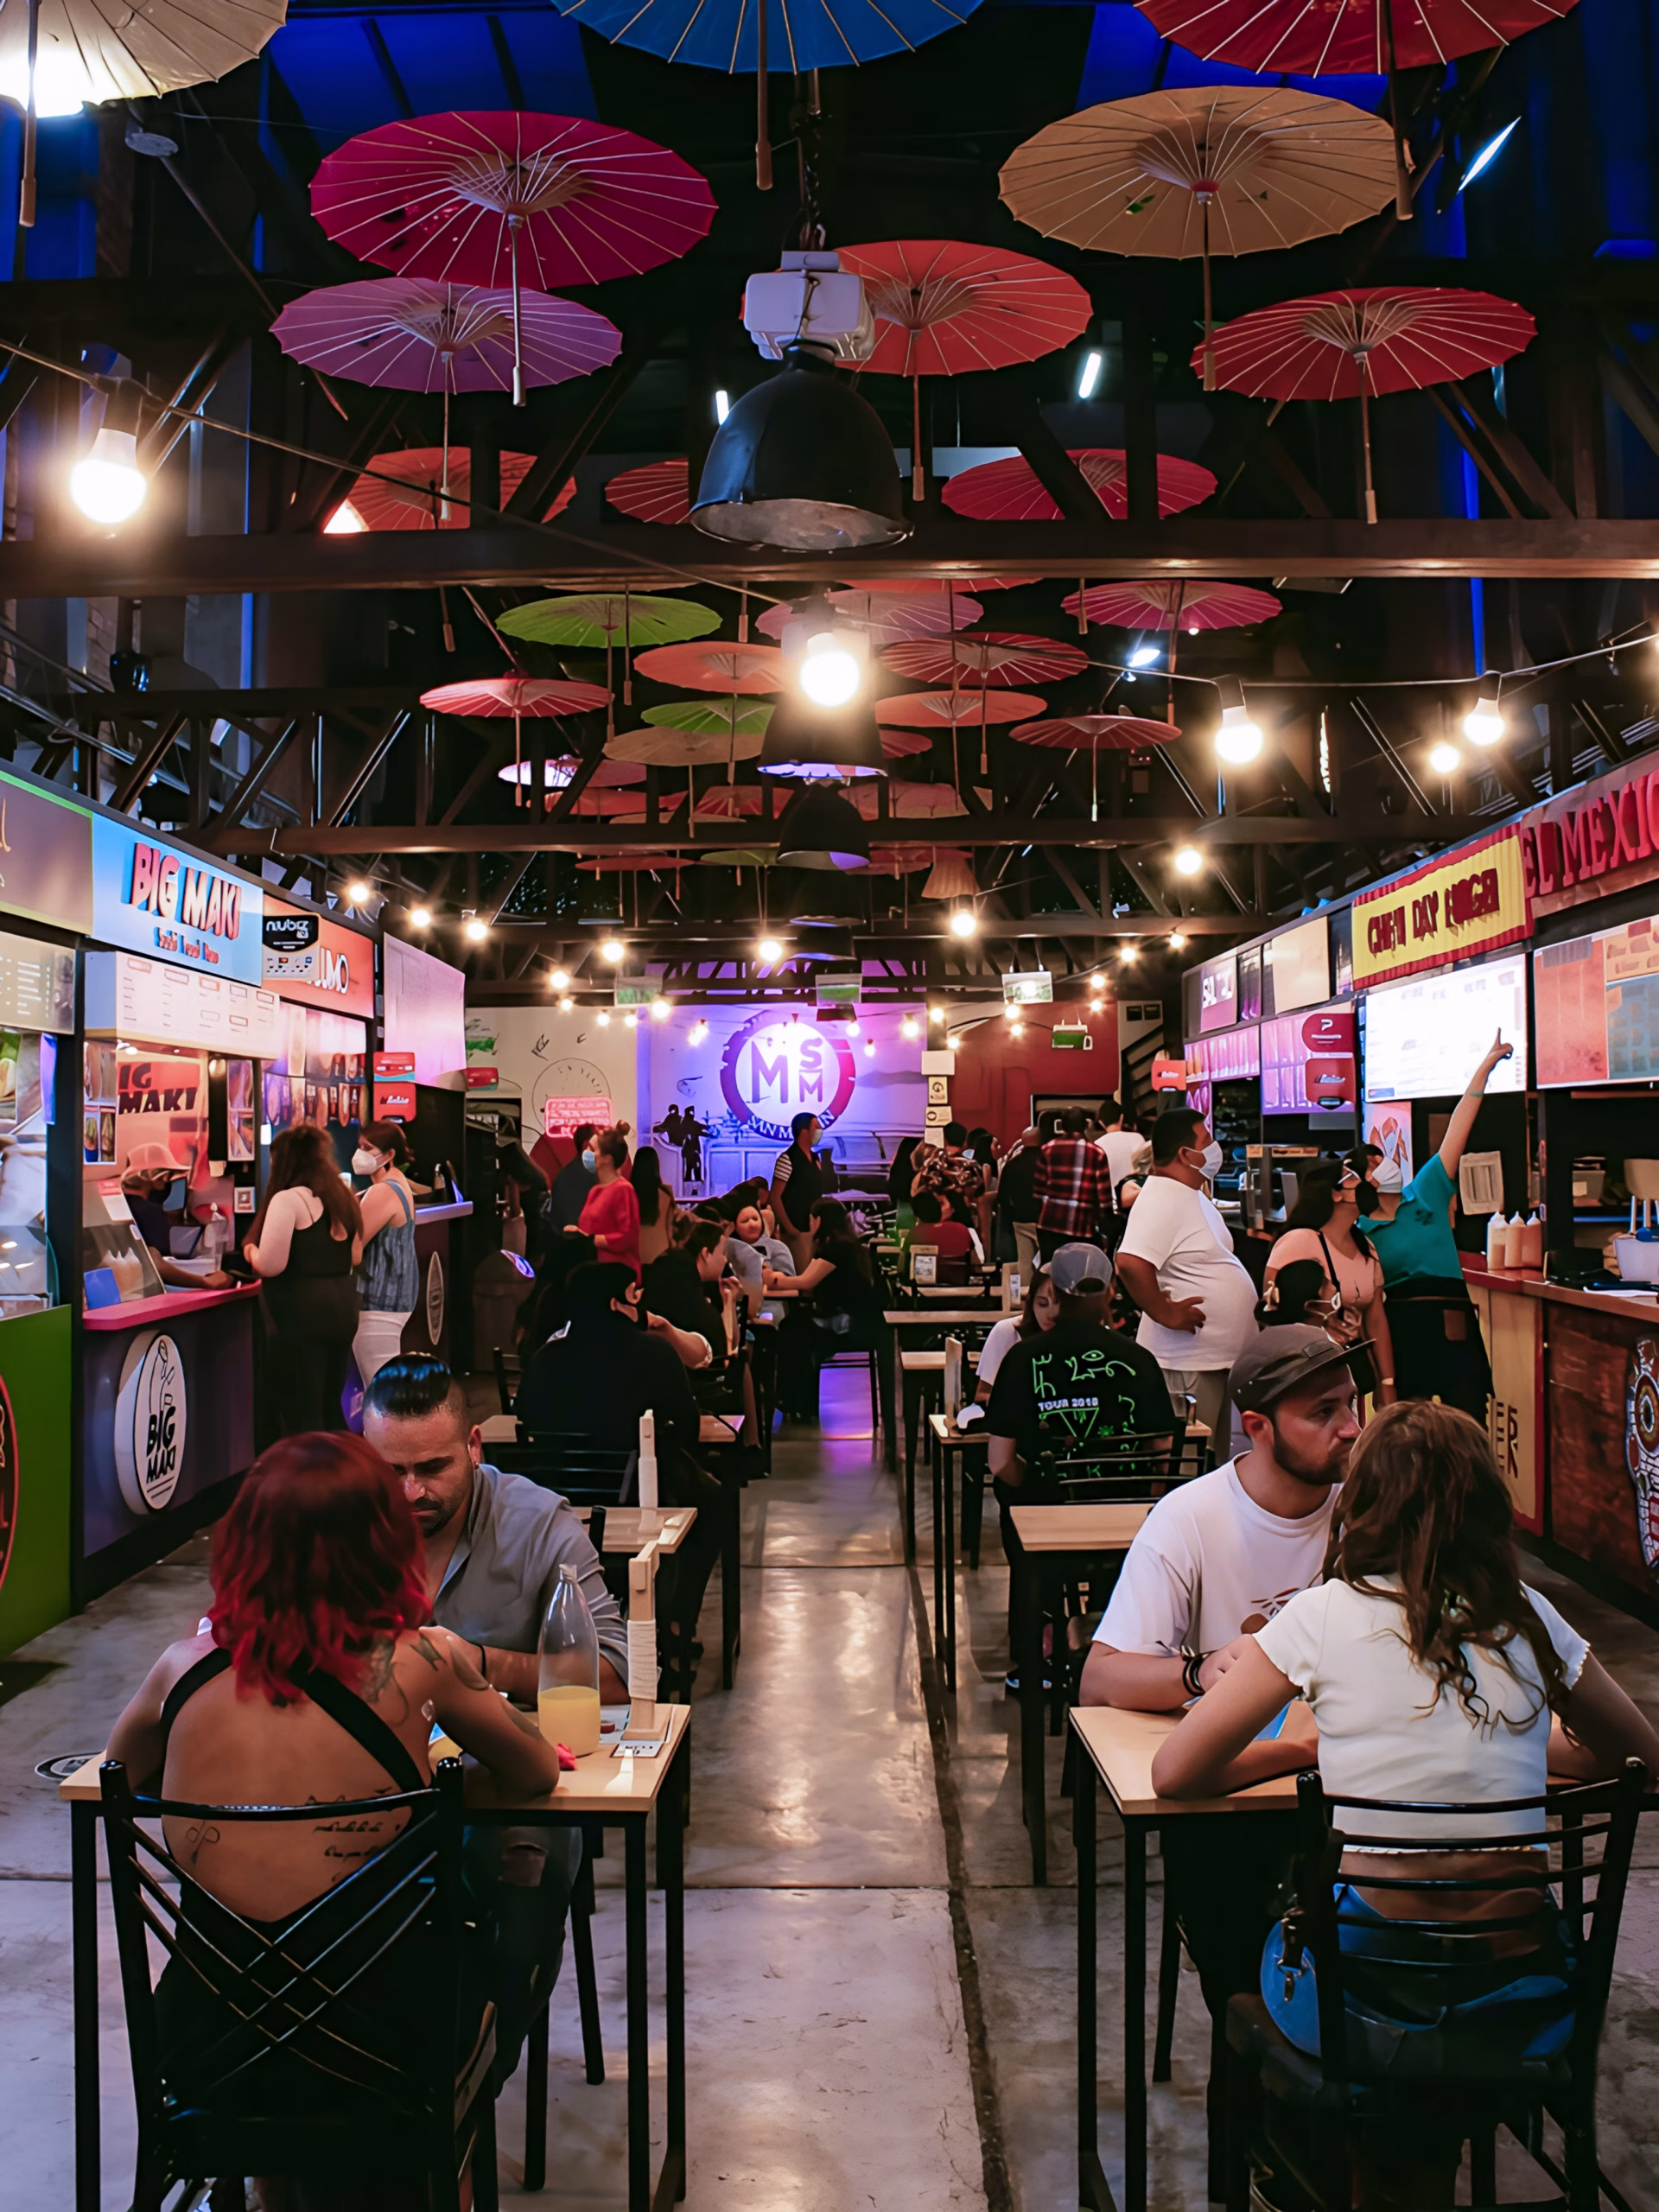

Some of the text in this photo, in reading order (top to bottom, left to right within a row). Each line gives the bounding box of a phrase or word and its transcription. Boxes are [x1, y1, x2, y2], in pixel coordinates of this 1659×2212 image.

[1522, 824, 1554, 899] EL
[130, 842, 242, 940] BIG MAKI
[118, 1063, 151, 1089] IG
[118, 1087, 198, 1115] MAKI
[1038, 1398, 1069, 1412] TOUR
[146, 1405, 176, 1457] BIG
